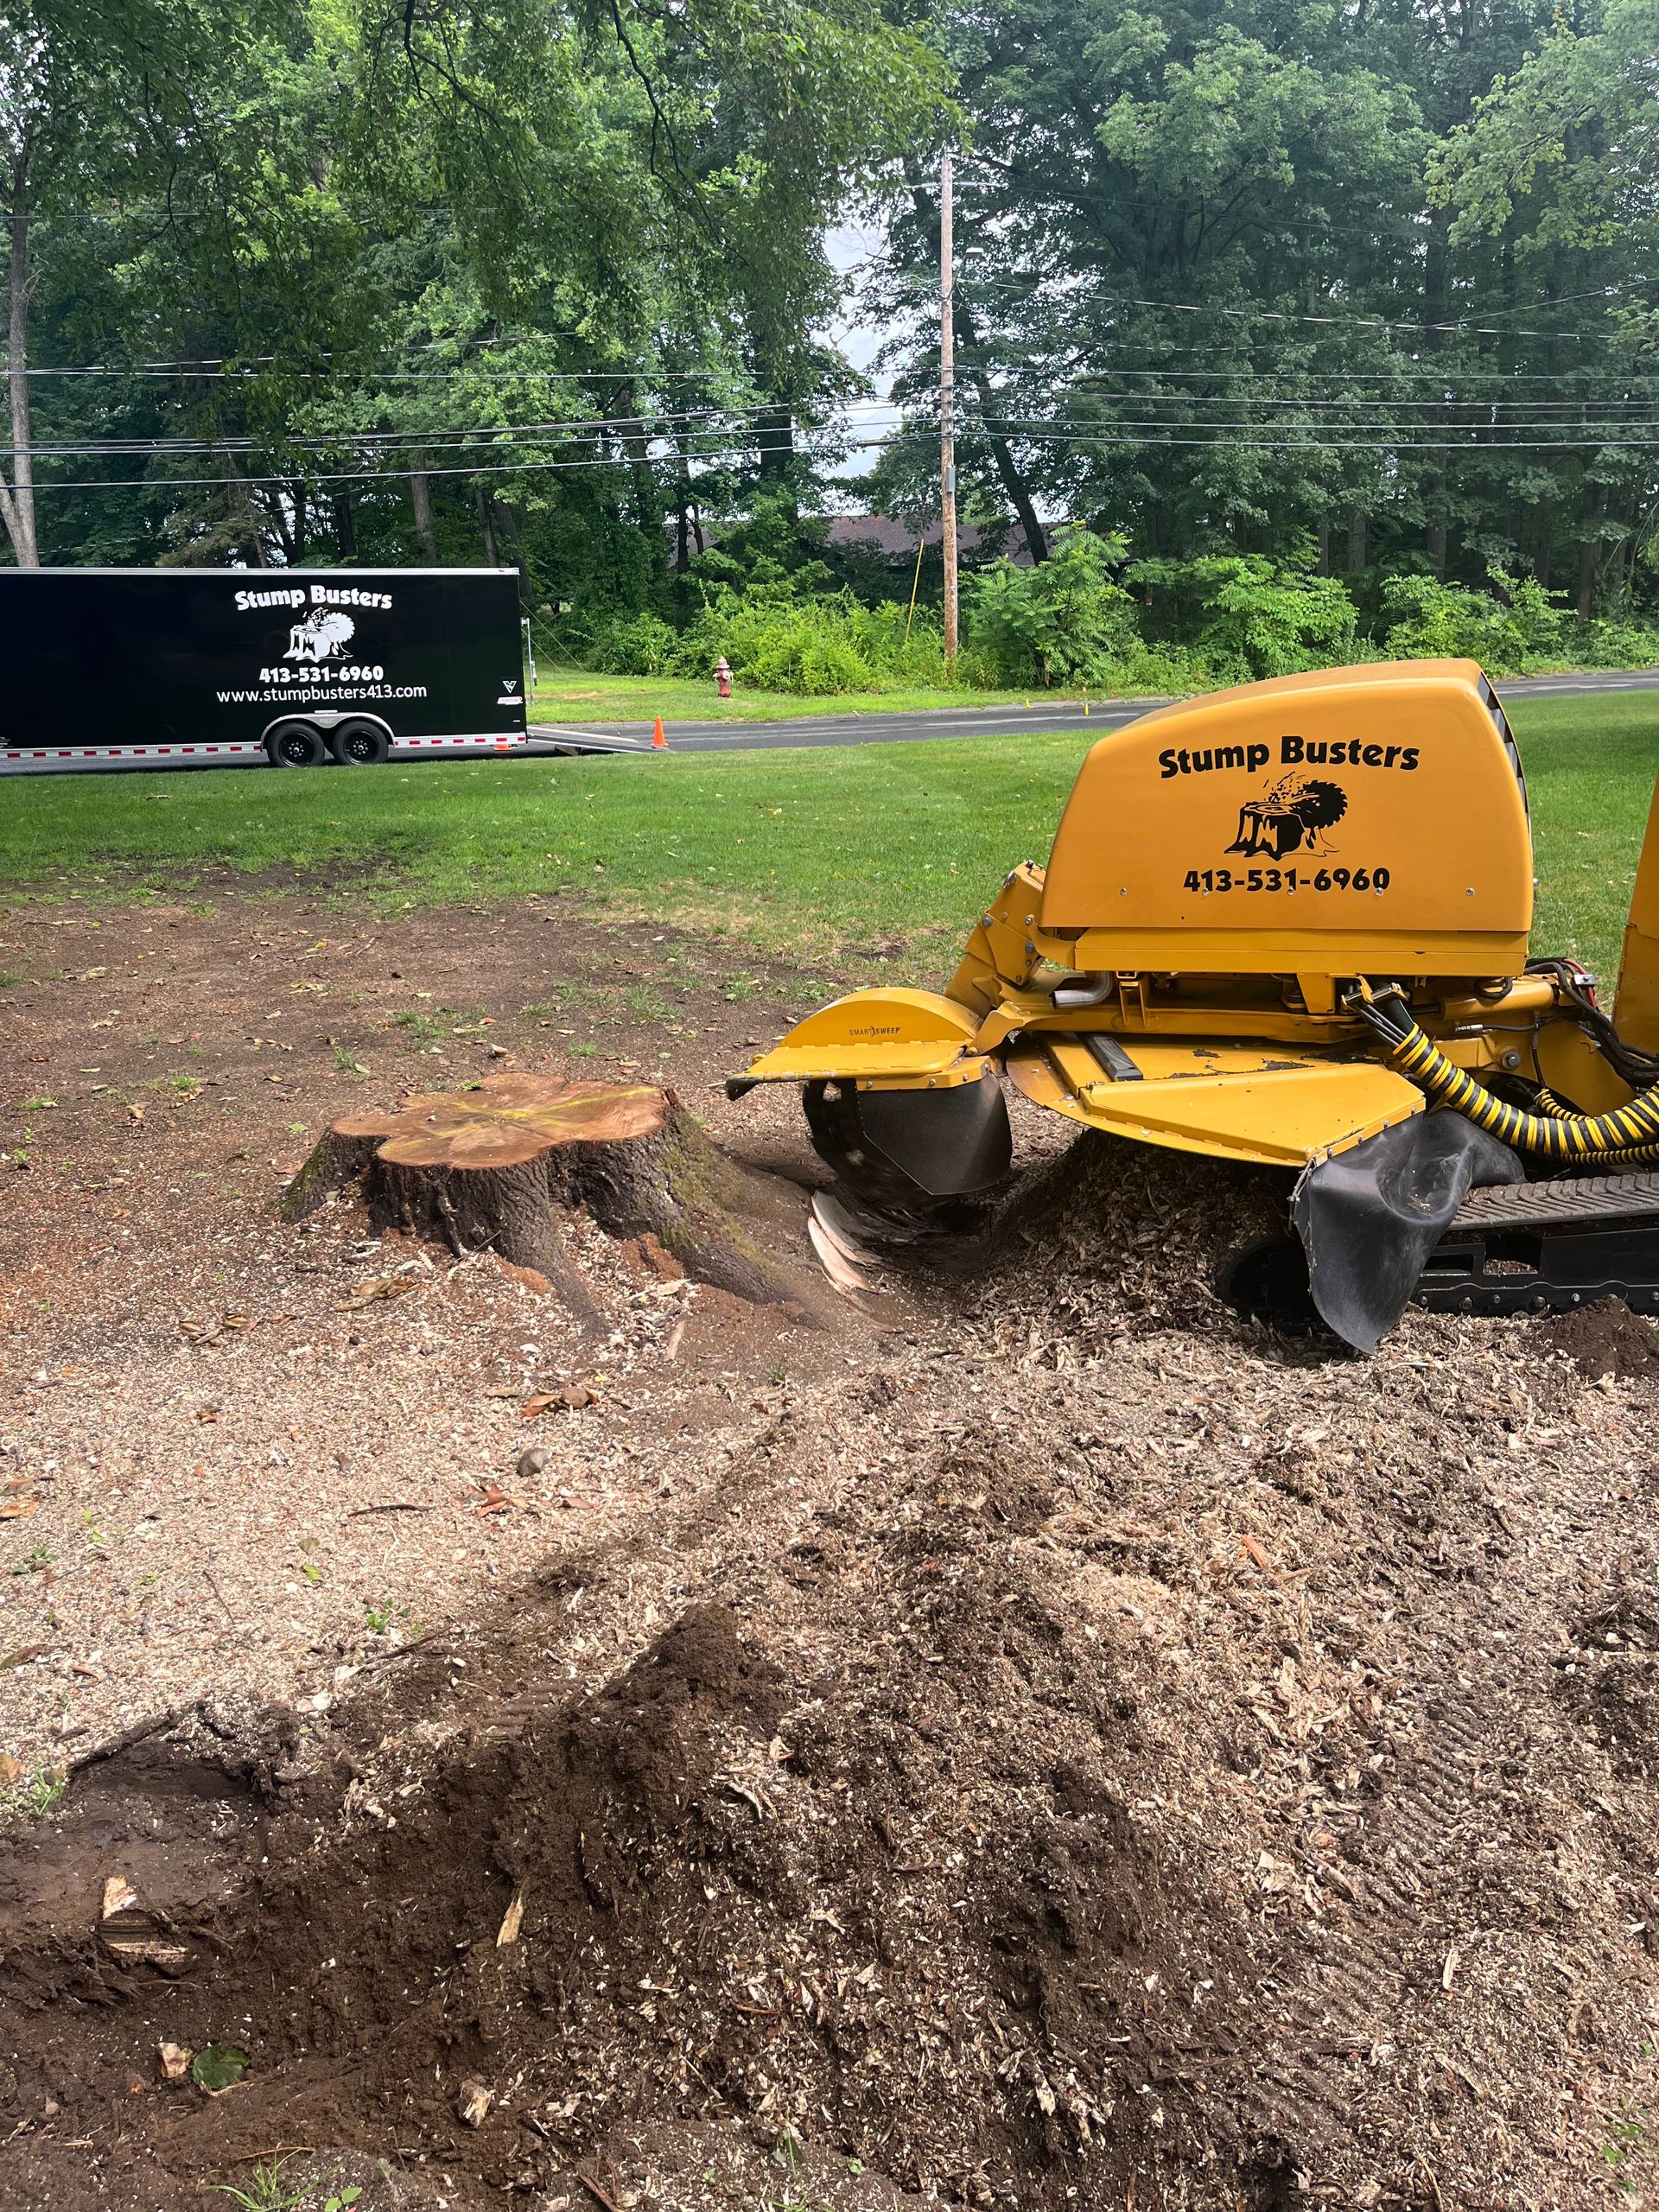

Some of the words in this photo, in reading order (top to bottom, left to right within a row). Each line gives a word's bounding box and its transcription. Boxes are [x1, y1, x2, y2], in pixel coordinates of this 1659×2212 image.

[234, 588, 306, 611] Stump
[310, 585, 392, 609] Busters
[259, 665, 384, 683] 413-531-6960
[216, 684, 428, 704] www.stumpbusters413.com
[1158, 742, 1270, 779] Stump
[1281, 735, 1420, 771] Busters
[1183, 868, 1390, 892] 413-531-6960
